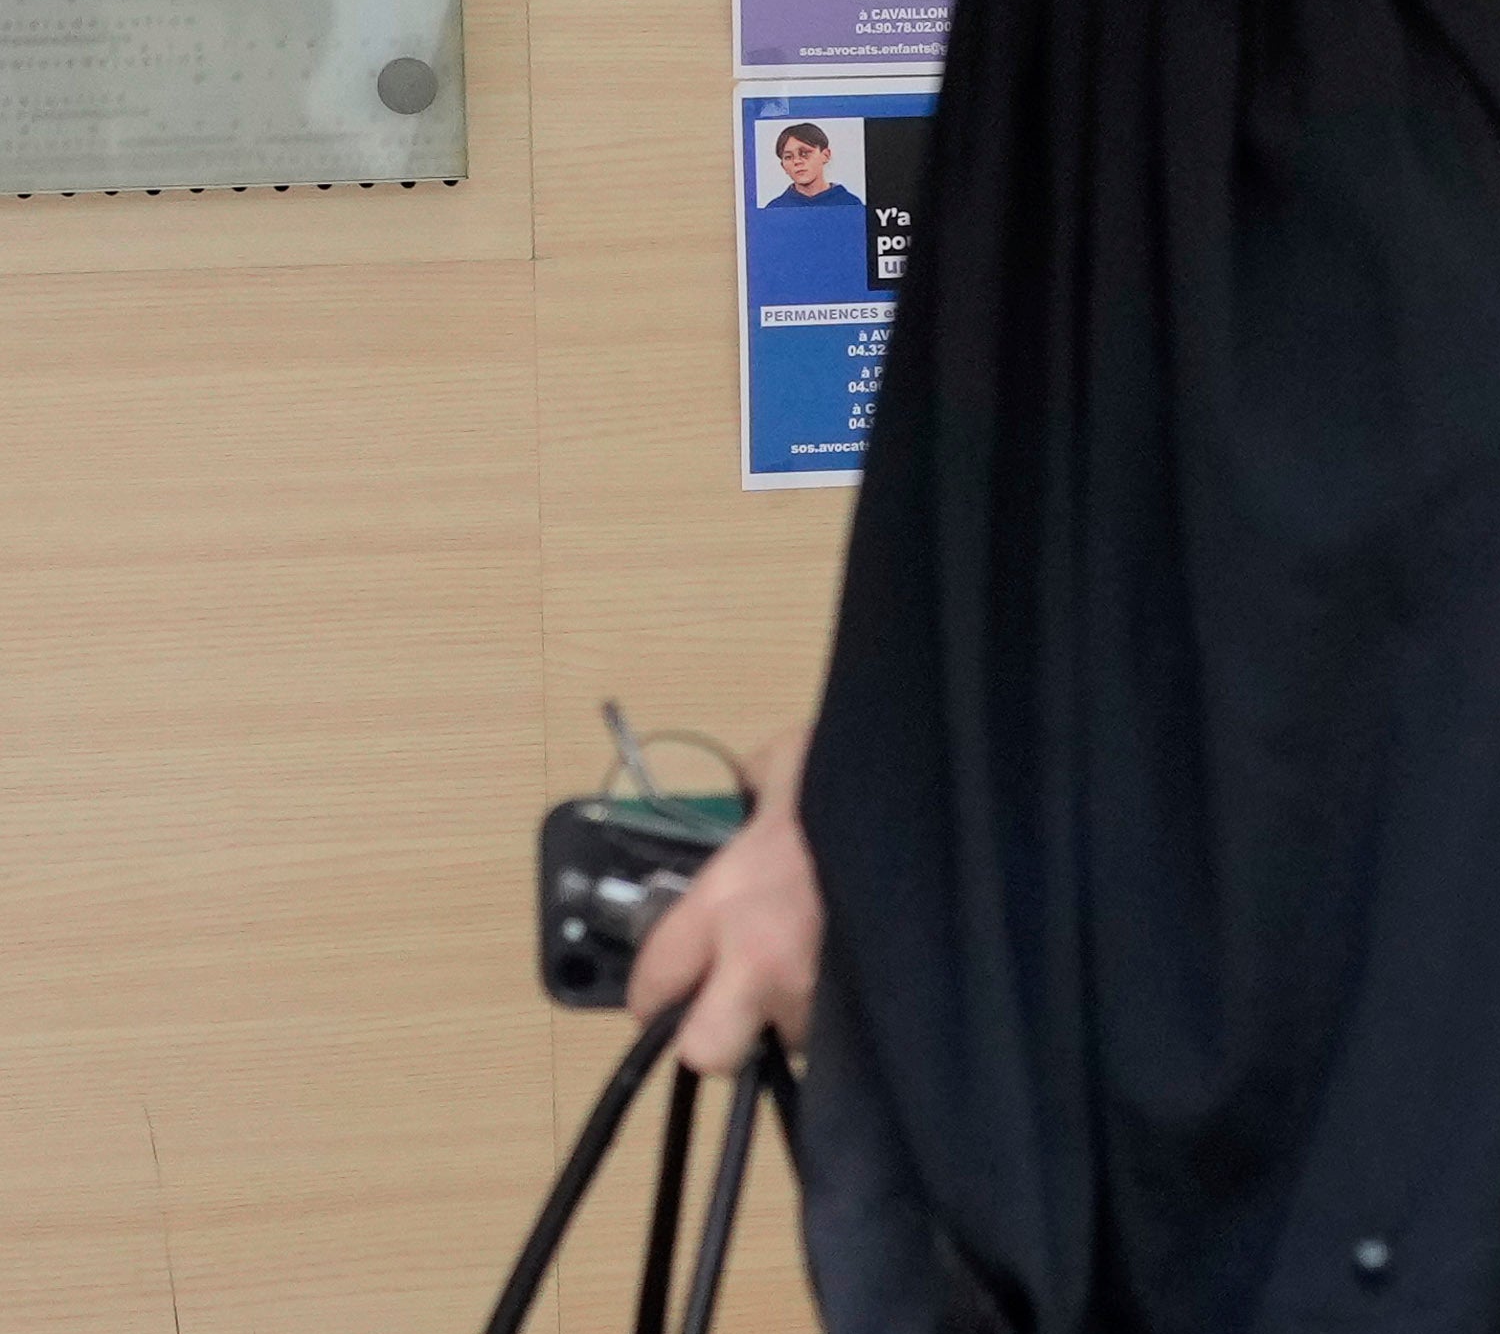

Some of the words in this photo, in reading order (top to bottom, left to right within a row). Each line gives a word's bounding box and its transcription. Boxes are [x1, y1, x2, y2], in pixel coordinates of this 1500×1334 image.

[871, 8, 949, 20] CAVAILLON
[876, 207, 911, 227] Y'a
[764, 307, 879, 322] PERMANENCES
[859, 330, 868, 342] à
